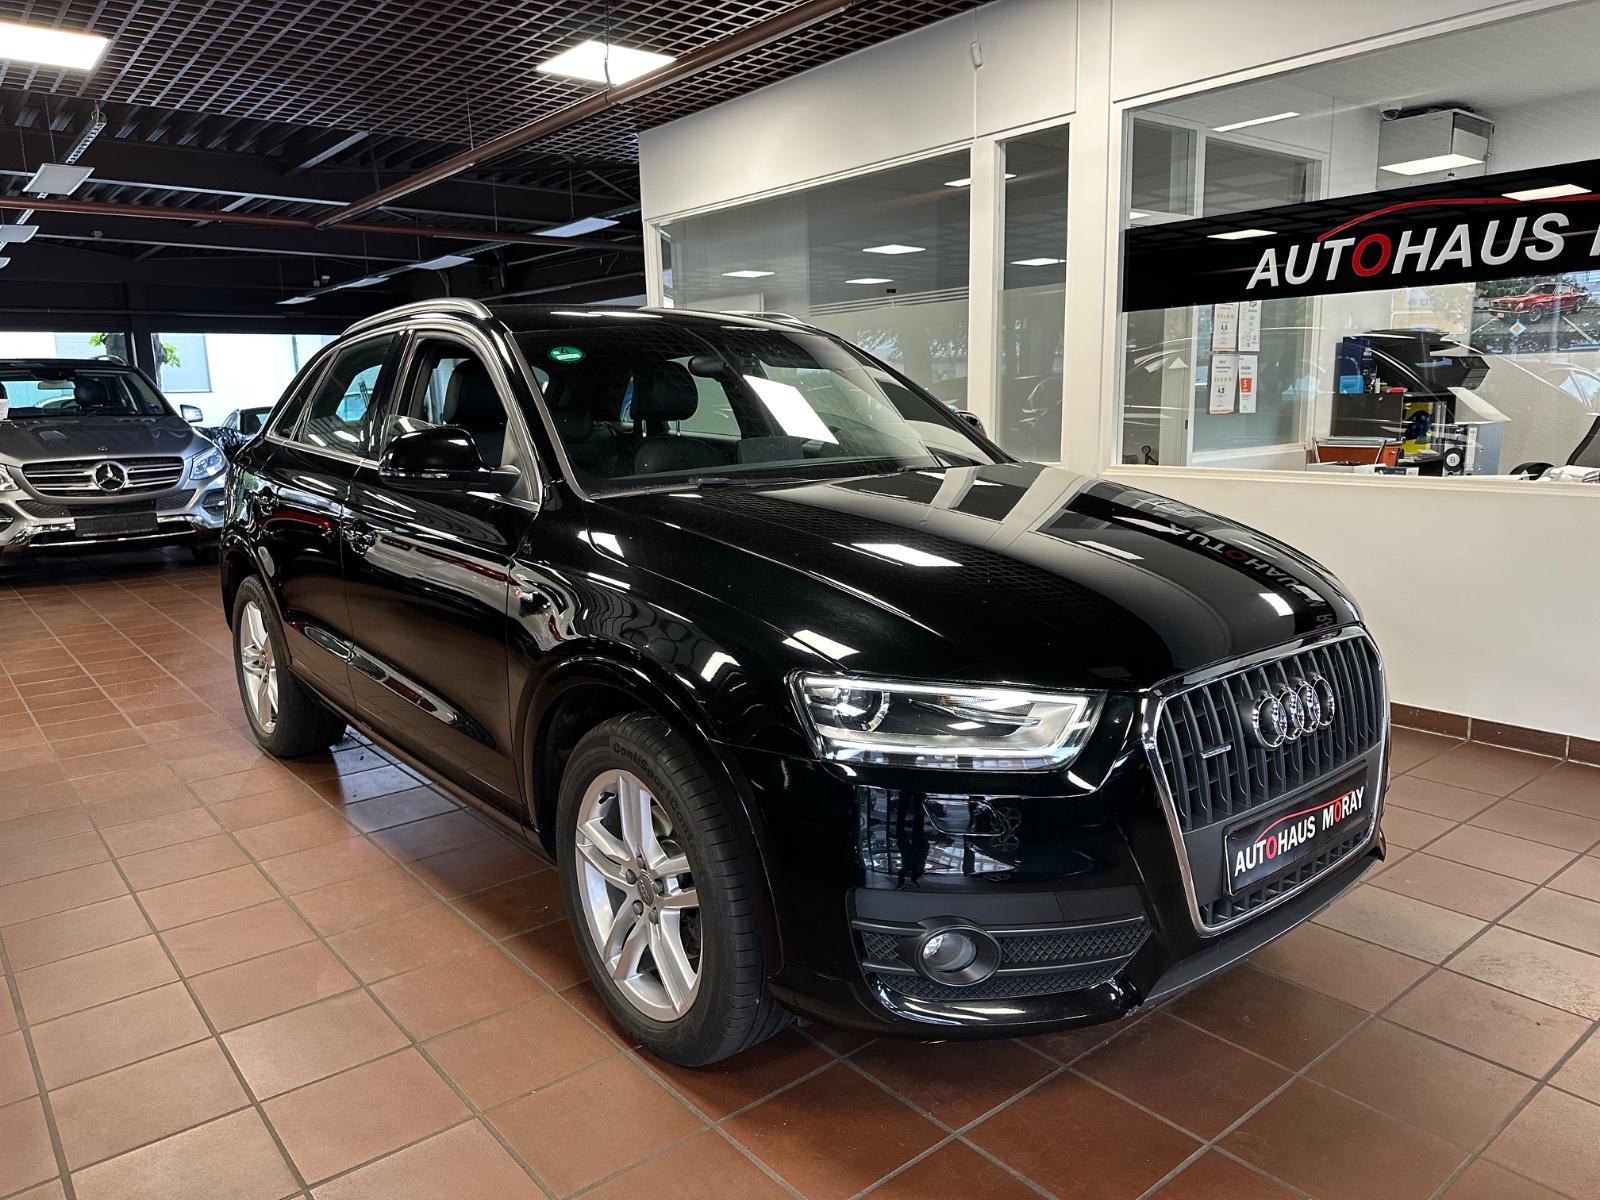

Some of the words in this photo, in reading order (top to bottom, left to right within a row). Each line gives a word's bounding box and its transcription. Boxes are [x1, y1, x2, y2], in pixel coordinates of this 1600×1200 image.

[1246, 212, 1570, 290] AUTOHAUS
[1234, 816, 1316, 877] AUTOHAUS
[1322, 786, 1365, 830] MORAY
